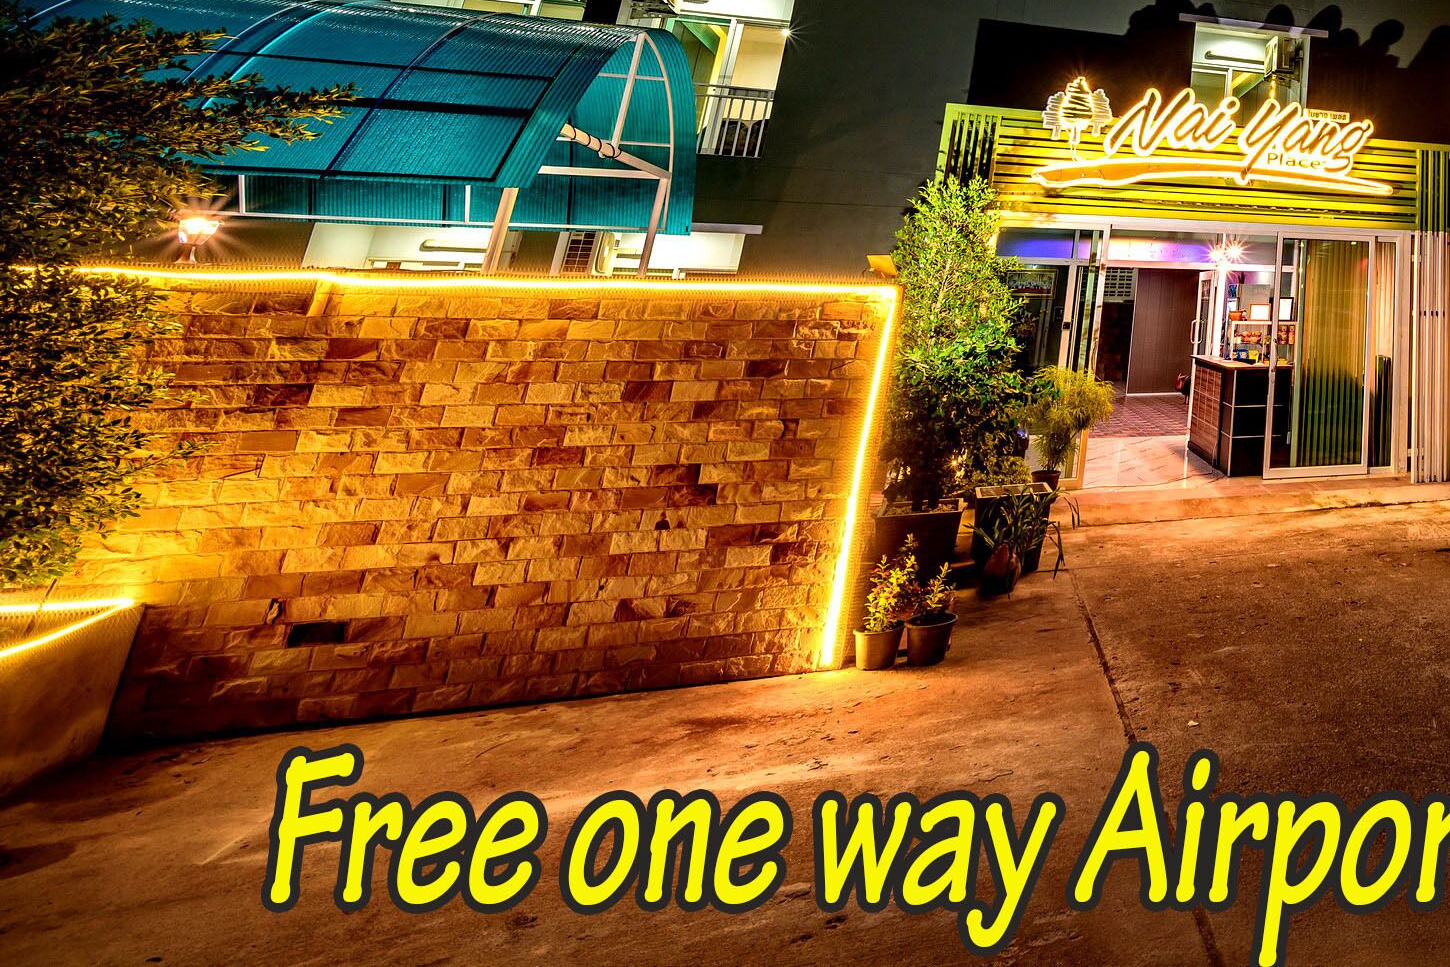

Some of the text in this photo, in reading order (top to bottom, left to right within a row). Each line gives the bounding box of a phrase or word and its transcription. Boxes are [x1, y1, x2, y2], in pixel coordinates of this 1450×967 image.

[1103, 87, 1374, 186] Nai Yang
[1266, 152, 1322, 170] Place
